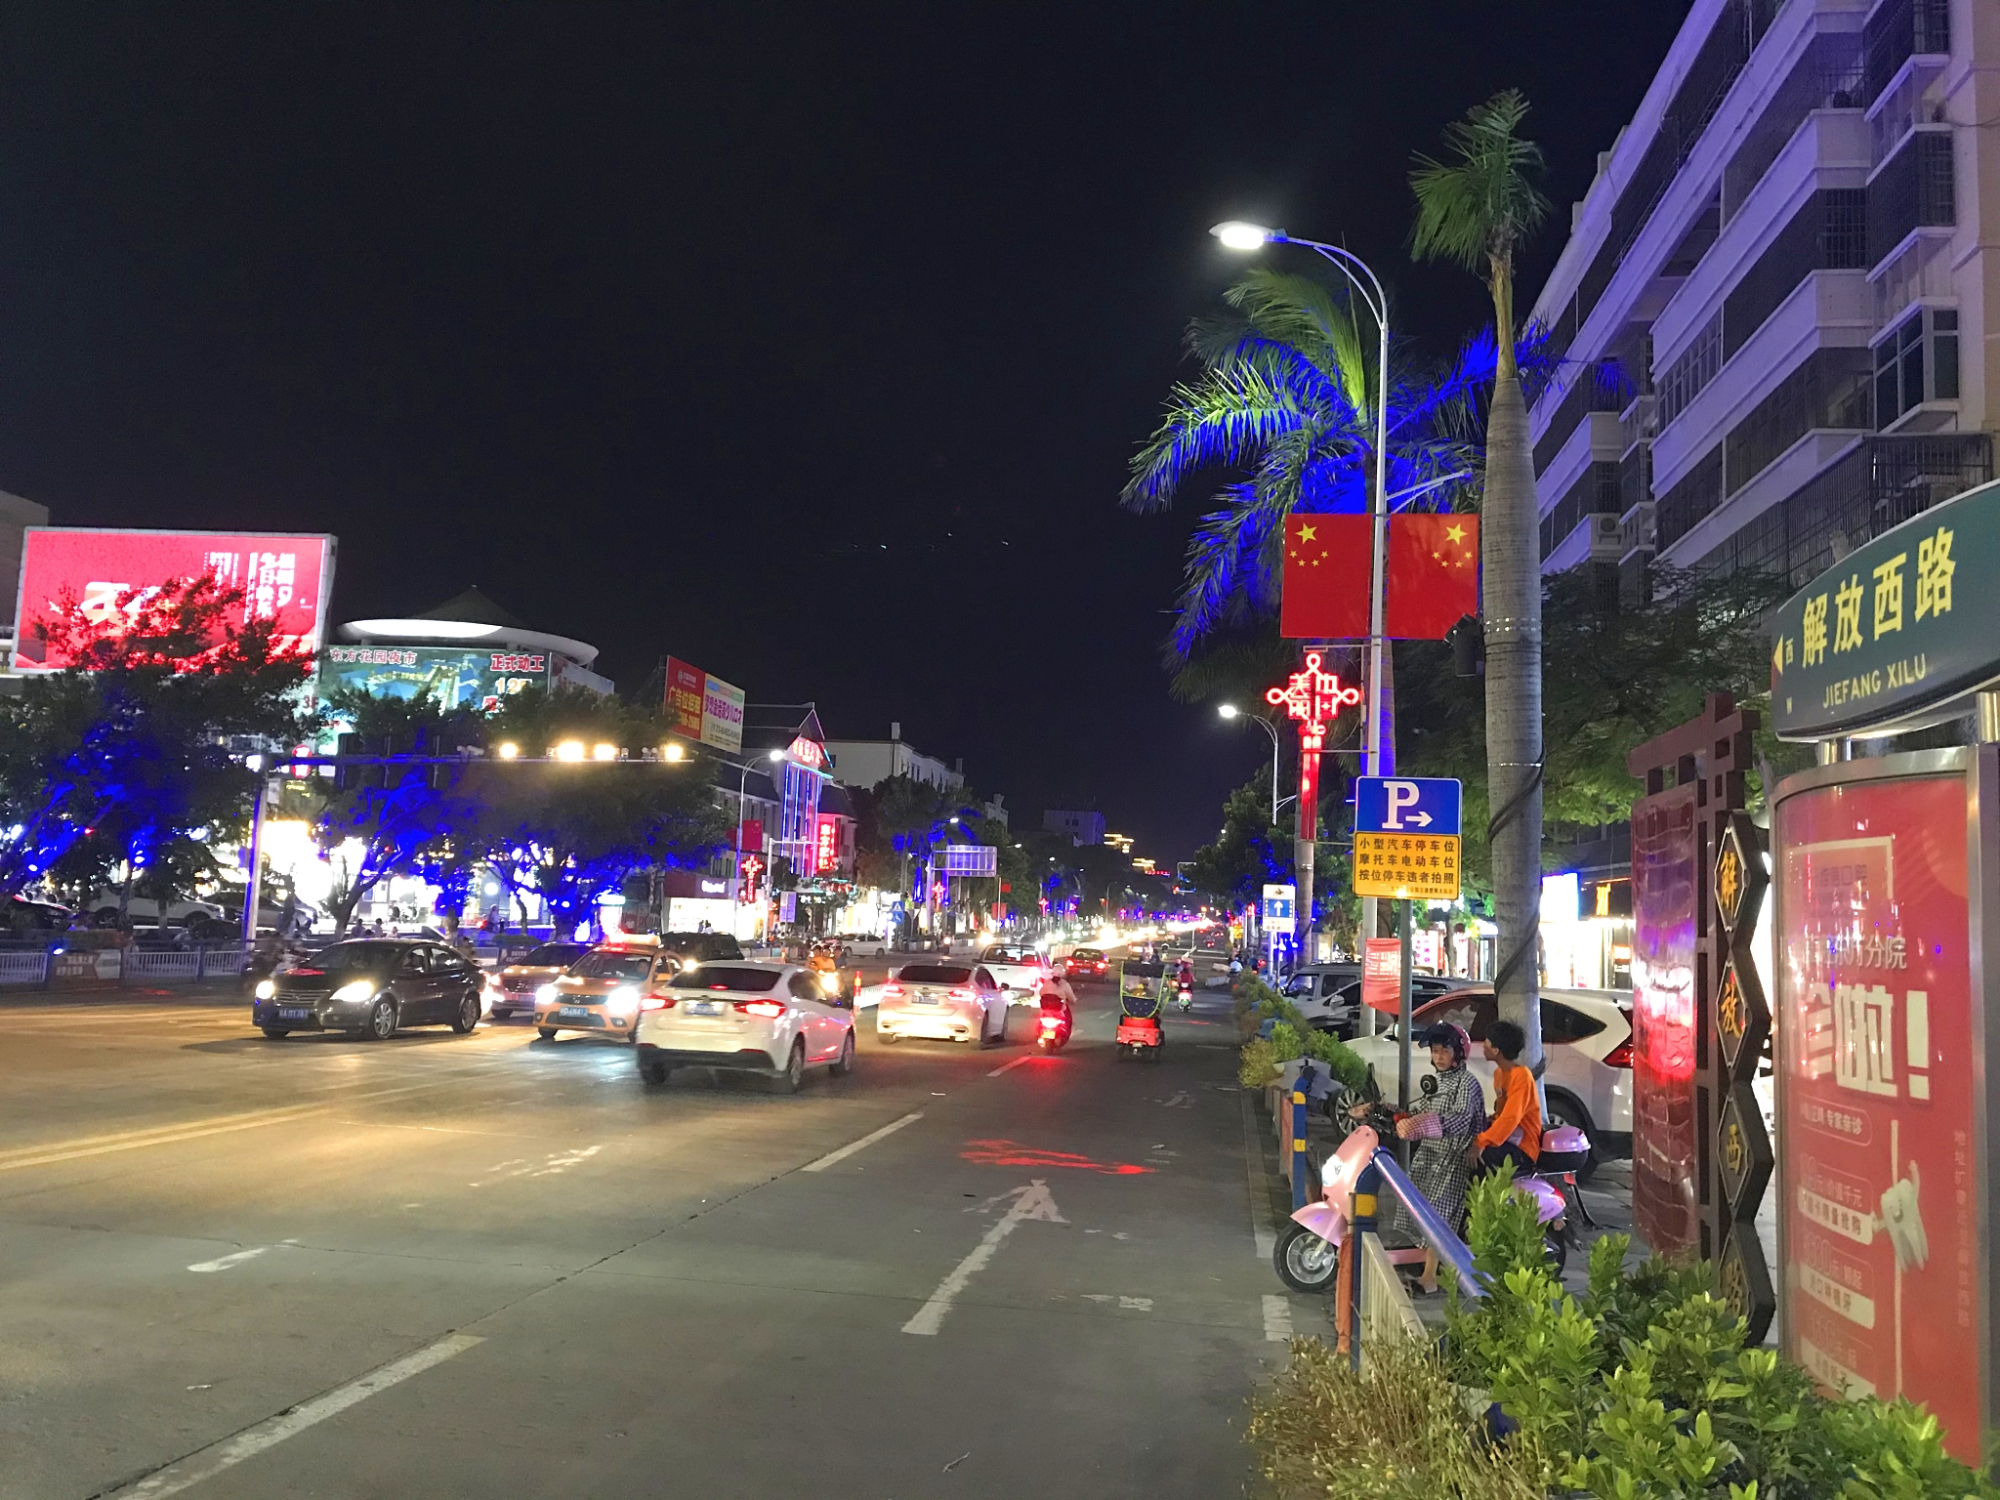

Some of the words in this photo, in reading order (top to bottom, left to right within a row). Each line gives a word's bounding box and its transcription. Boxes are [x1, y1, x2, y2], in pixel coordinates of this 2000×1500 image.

[1802, 526, 1956, 669] 解放西路
[330, 648, 417, 666] 东方花园夜市
[1785, 638, 1794, 666] 西
[490, 654, 544, 672] 正式动工
[1822, 668, 1881, 709] JIEFANG
[1887, 653, 1927, 690] XILU
[1382, 781, 1420, 829] P
[1360, 837, 1455, 853] 小型汽车停车位
[1359, 852, 1455, 869] 摩托车电动车位
[1359, 868, 1455, 885] 按位停车违者拍照
